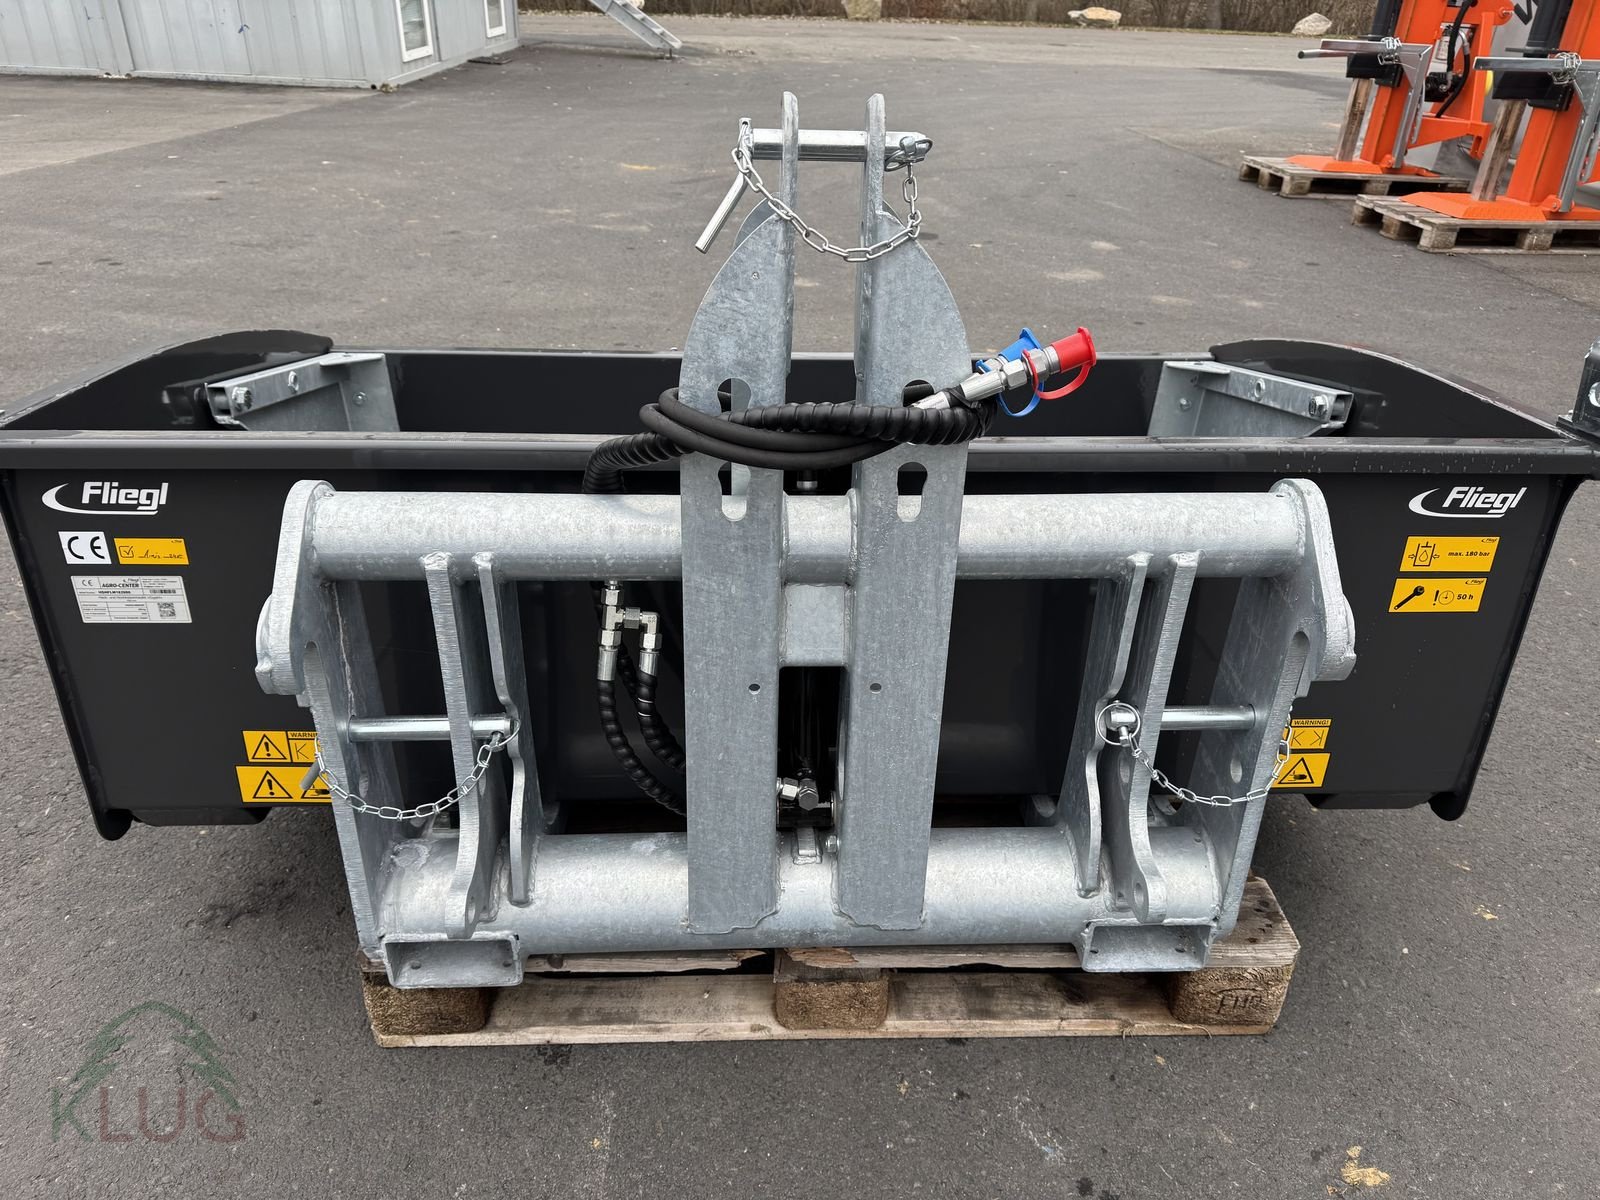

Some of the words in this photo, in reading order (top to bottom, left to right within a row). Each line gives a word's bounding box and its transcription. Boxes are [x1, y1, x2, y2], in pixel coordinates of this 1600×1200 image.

[81, 481, 169, 511] Fliegl
[1442, 486, 1528, 514] Fliegl
[67, 535, 105, 560] CE
